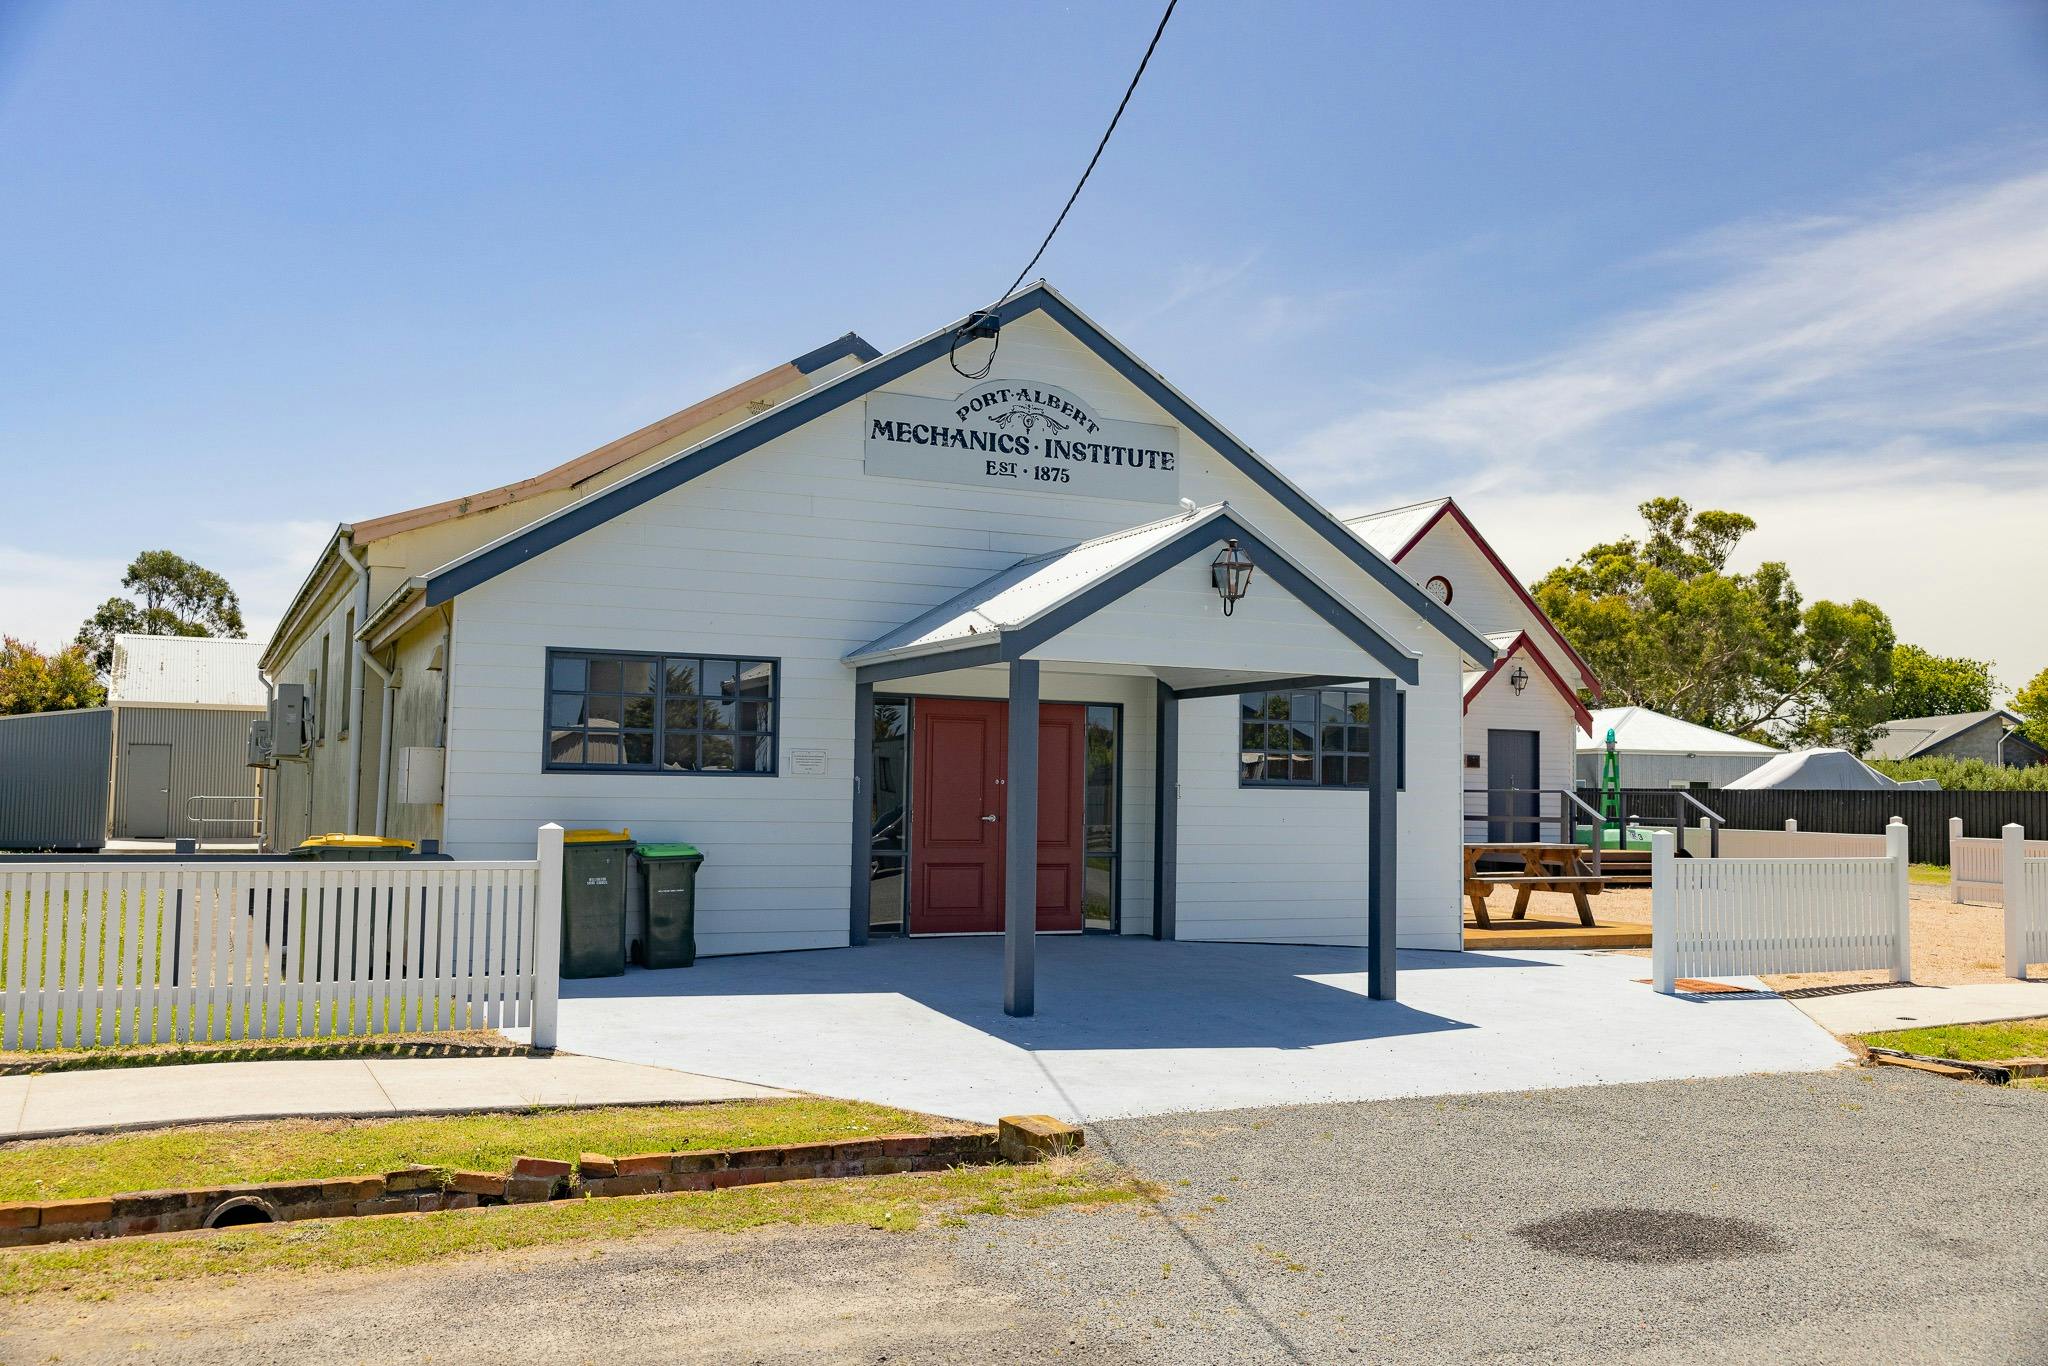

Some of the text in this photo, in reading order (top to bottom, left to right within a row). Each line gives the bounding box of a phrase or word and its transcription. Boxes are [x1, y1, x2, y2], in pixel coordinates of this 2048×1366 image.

[1016, 388, 1100, 436] ALBERT
[871, 419, 1175, 472] MECHANICS INSTITUTE
[1033, 465, 1070, 483] 1875
